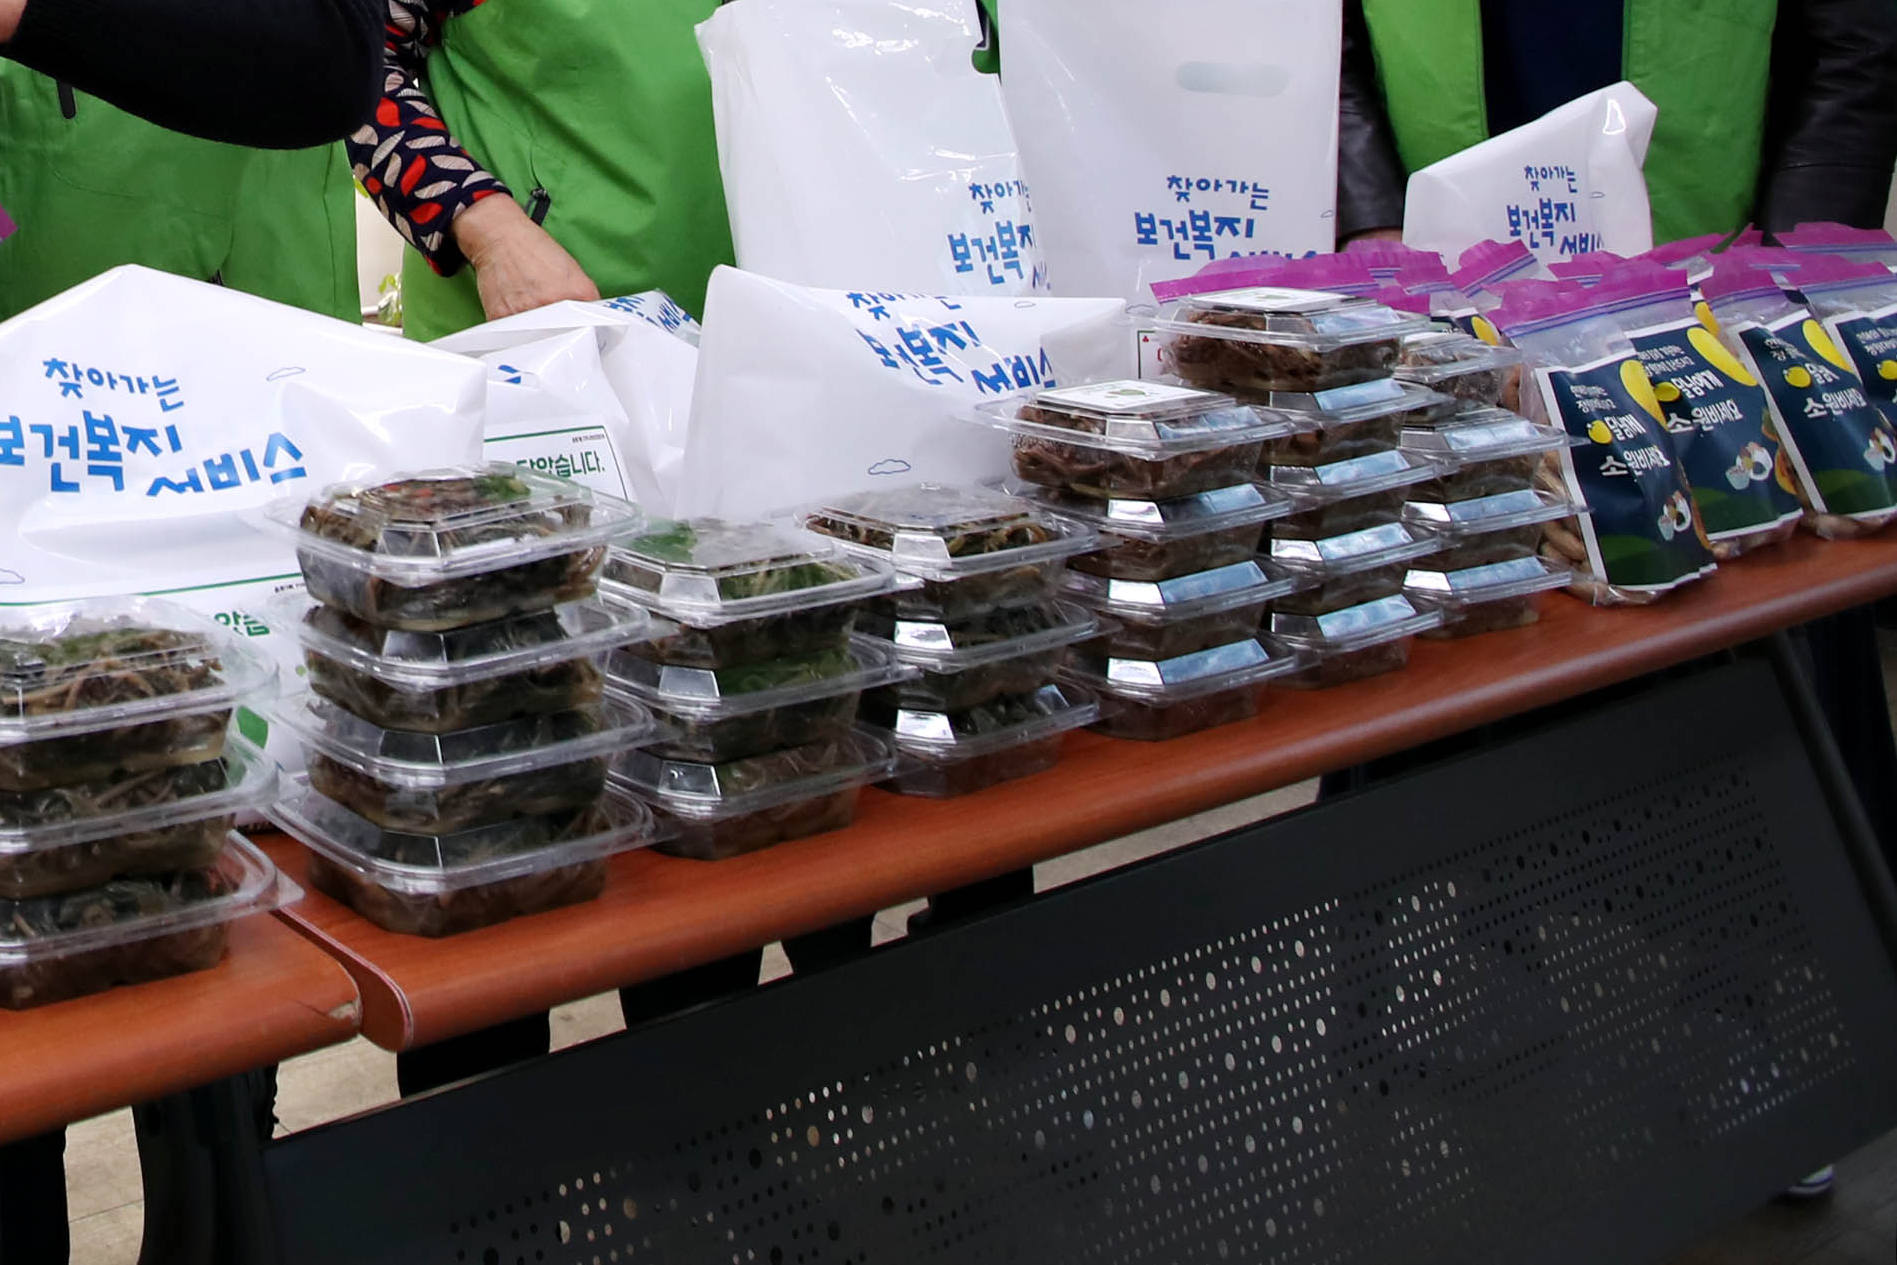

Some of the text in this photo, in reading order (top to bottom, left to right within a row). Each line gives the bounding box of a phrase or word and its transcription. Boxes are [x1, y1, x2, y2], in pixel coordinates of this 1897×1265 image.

[1166, 175, 1270, 211] 찾아가는
[1524, 166, 1578, 193] 찾아가는
[1134, 209, 1255, 261] 보건복지
[1506, 198, 1576, 248] 보건복지
[43, 357, 185, 413] 찾아가는
[146, 431, 308, 497] 서비스
